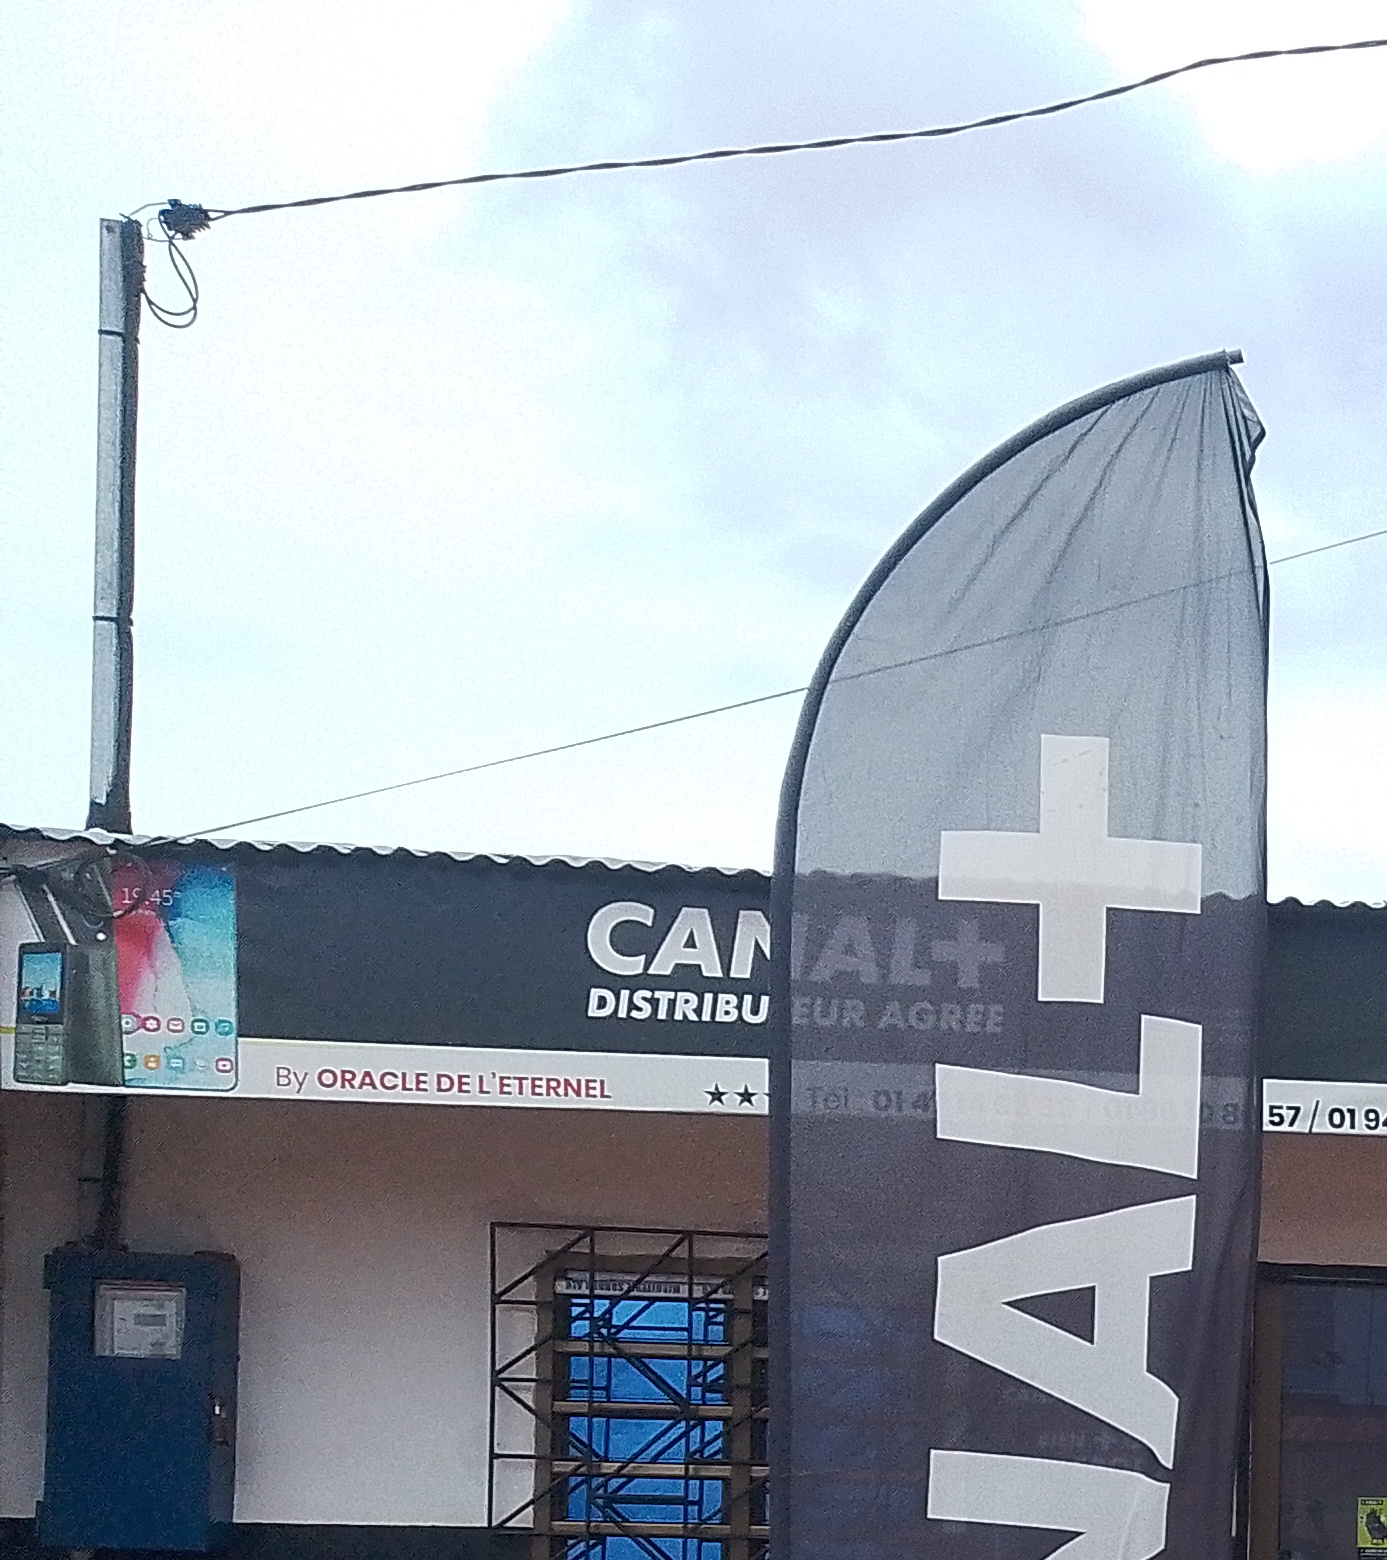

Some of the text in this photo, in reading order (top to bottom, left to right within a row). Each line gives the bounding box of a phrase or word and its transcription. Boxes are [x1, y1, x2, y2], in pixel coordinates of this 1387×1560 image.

[587, 987, 866, 1028] DISTRIBUEUR
[275, 1066, 612, 1099] By ORACLE DE L'ETERNEL
[1268, 1105, 1302, 1128] 57
[1328, 1107, 1356, 1130] 01
